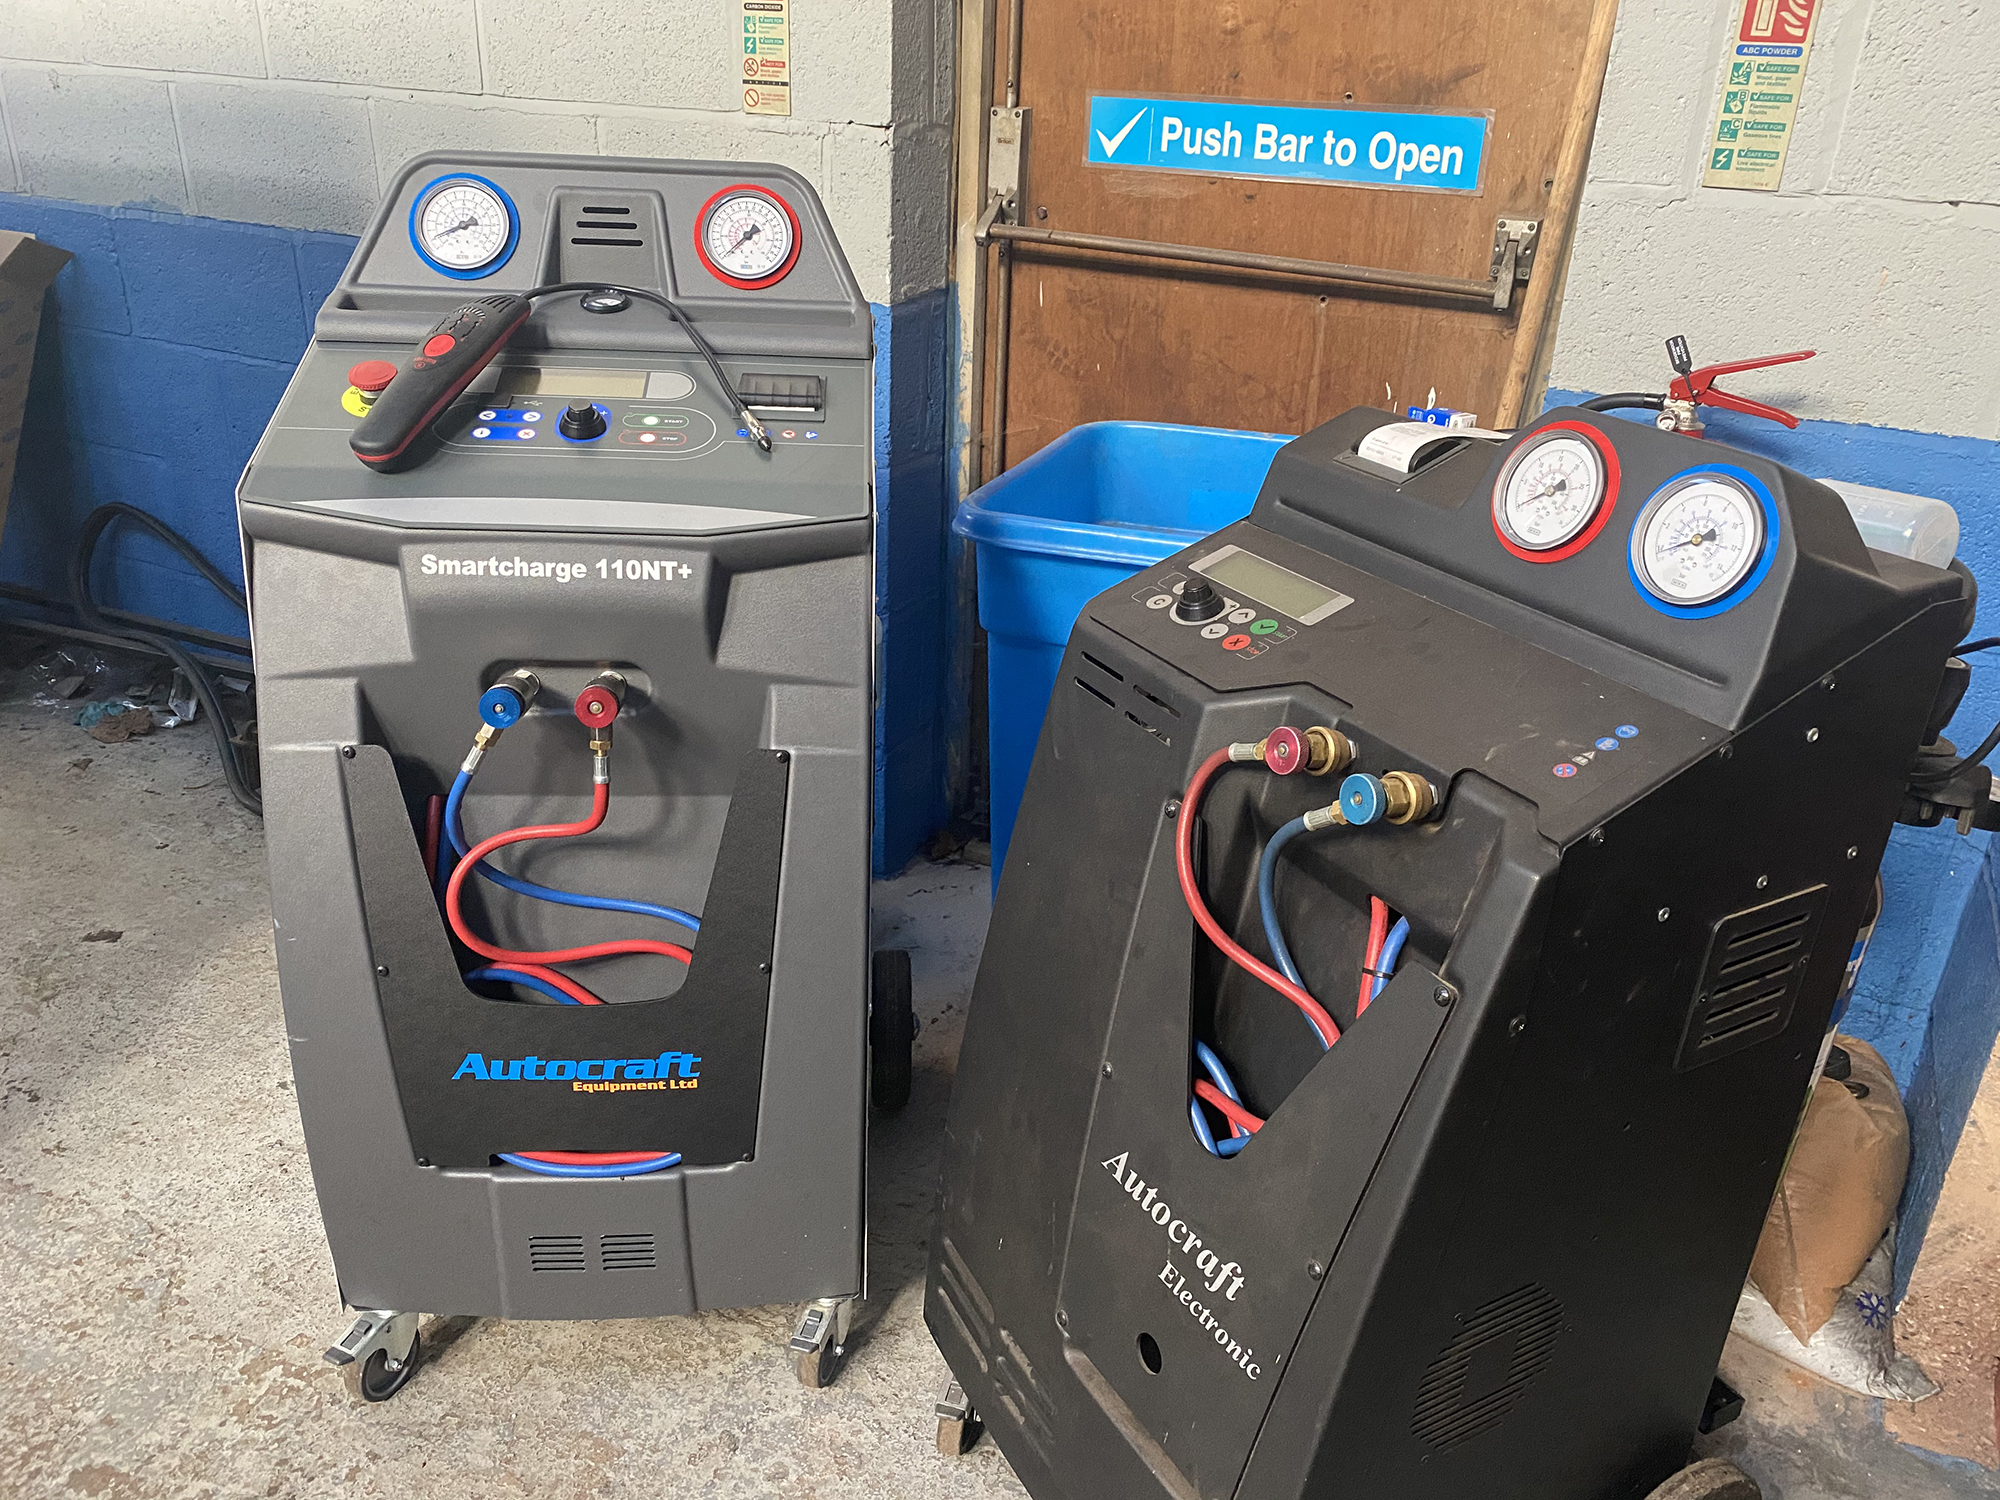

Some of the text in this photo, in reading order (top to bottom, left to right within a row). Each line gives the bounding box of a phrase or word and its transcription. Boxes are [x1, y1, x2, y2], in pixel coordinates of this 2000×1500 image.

[1761, 47, 1798, 55] POWDER
[1745, 62, 1752, 71] A
[1740, 92, 1747, 100] B
[1732, 120, 1740, 128] C
[1160, 116, 1463, 181] Push Bar to Open
[420, 554, 693, 582] Smartcharge 110NT+
[451, 1051, 702, 1080] Autocraft
[572, 1079, 698, 1093] Equipment Ltd
[1101, 1151, 1245, 1301] Autocraft
[1158, 1260, 1261, 1380] Electronic
